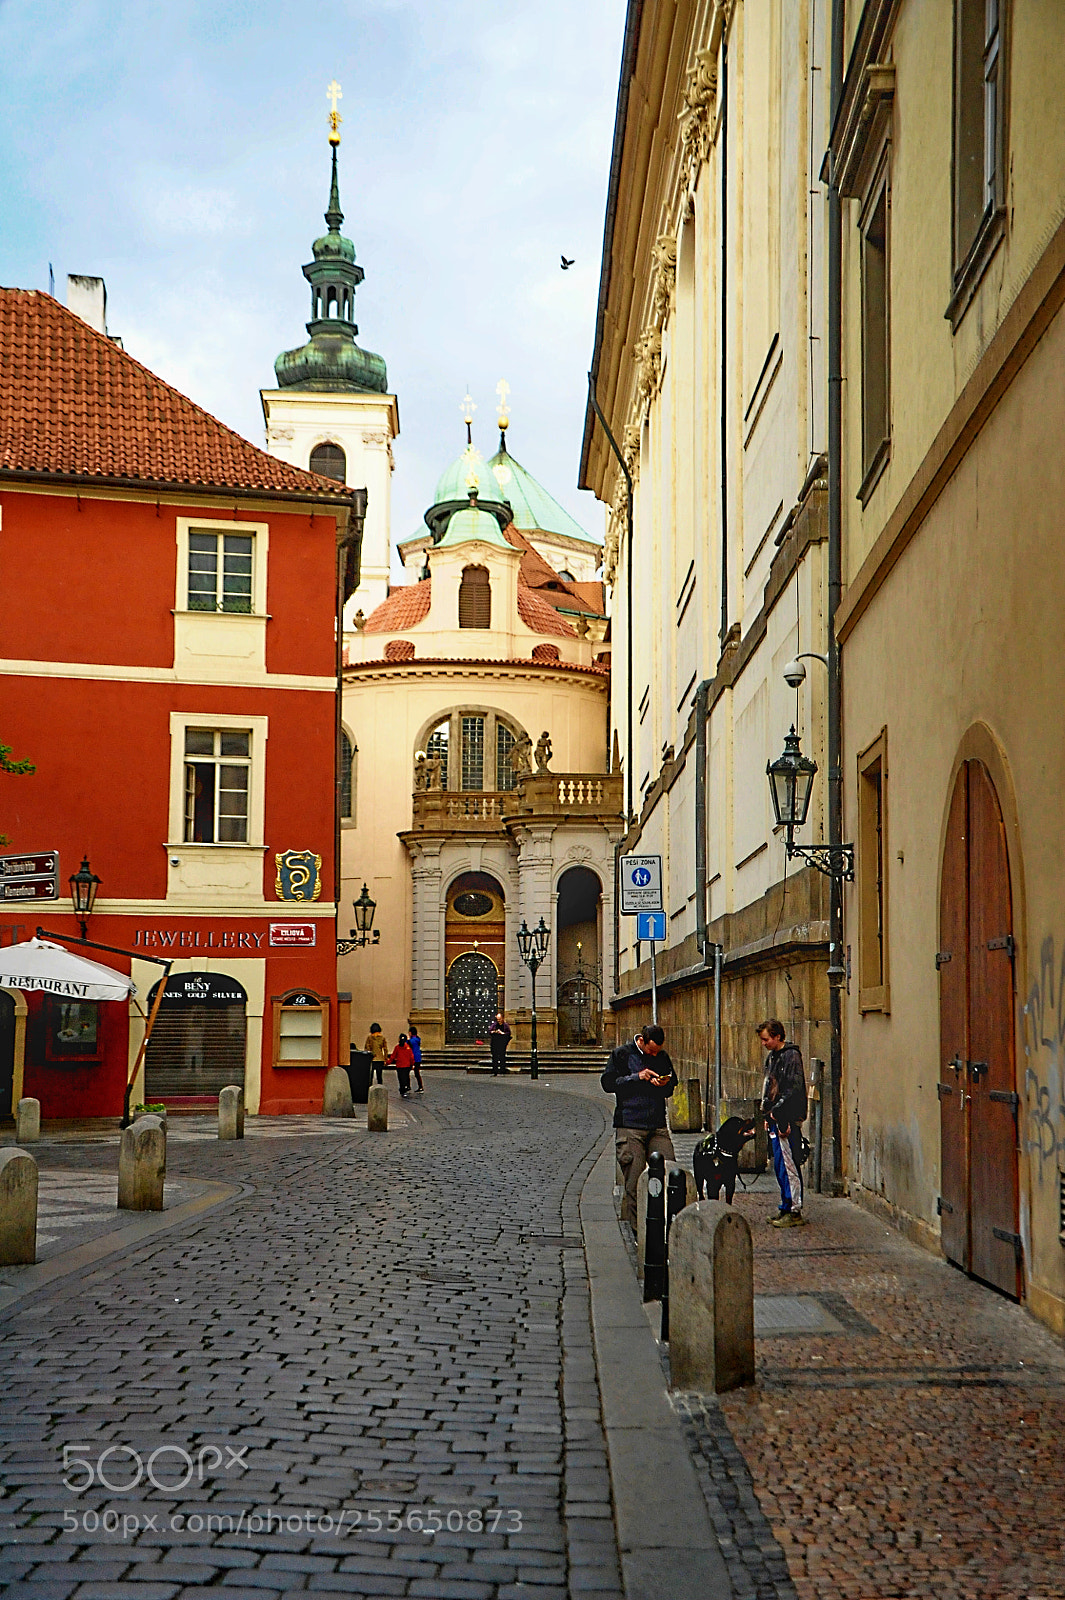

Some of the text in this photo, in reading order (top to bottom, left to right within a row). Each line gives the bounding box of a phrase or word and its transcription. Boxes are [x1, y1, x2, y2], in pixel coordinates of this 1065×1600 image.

[132, 930, 266, 949] JEWELLERY
[8, 976, 90, 997] RESTAURANT
[184, 982, 211, 990] BENY
